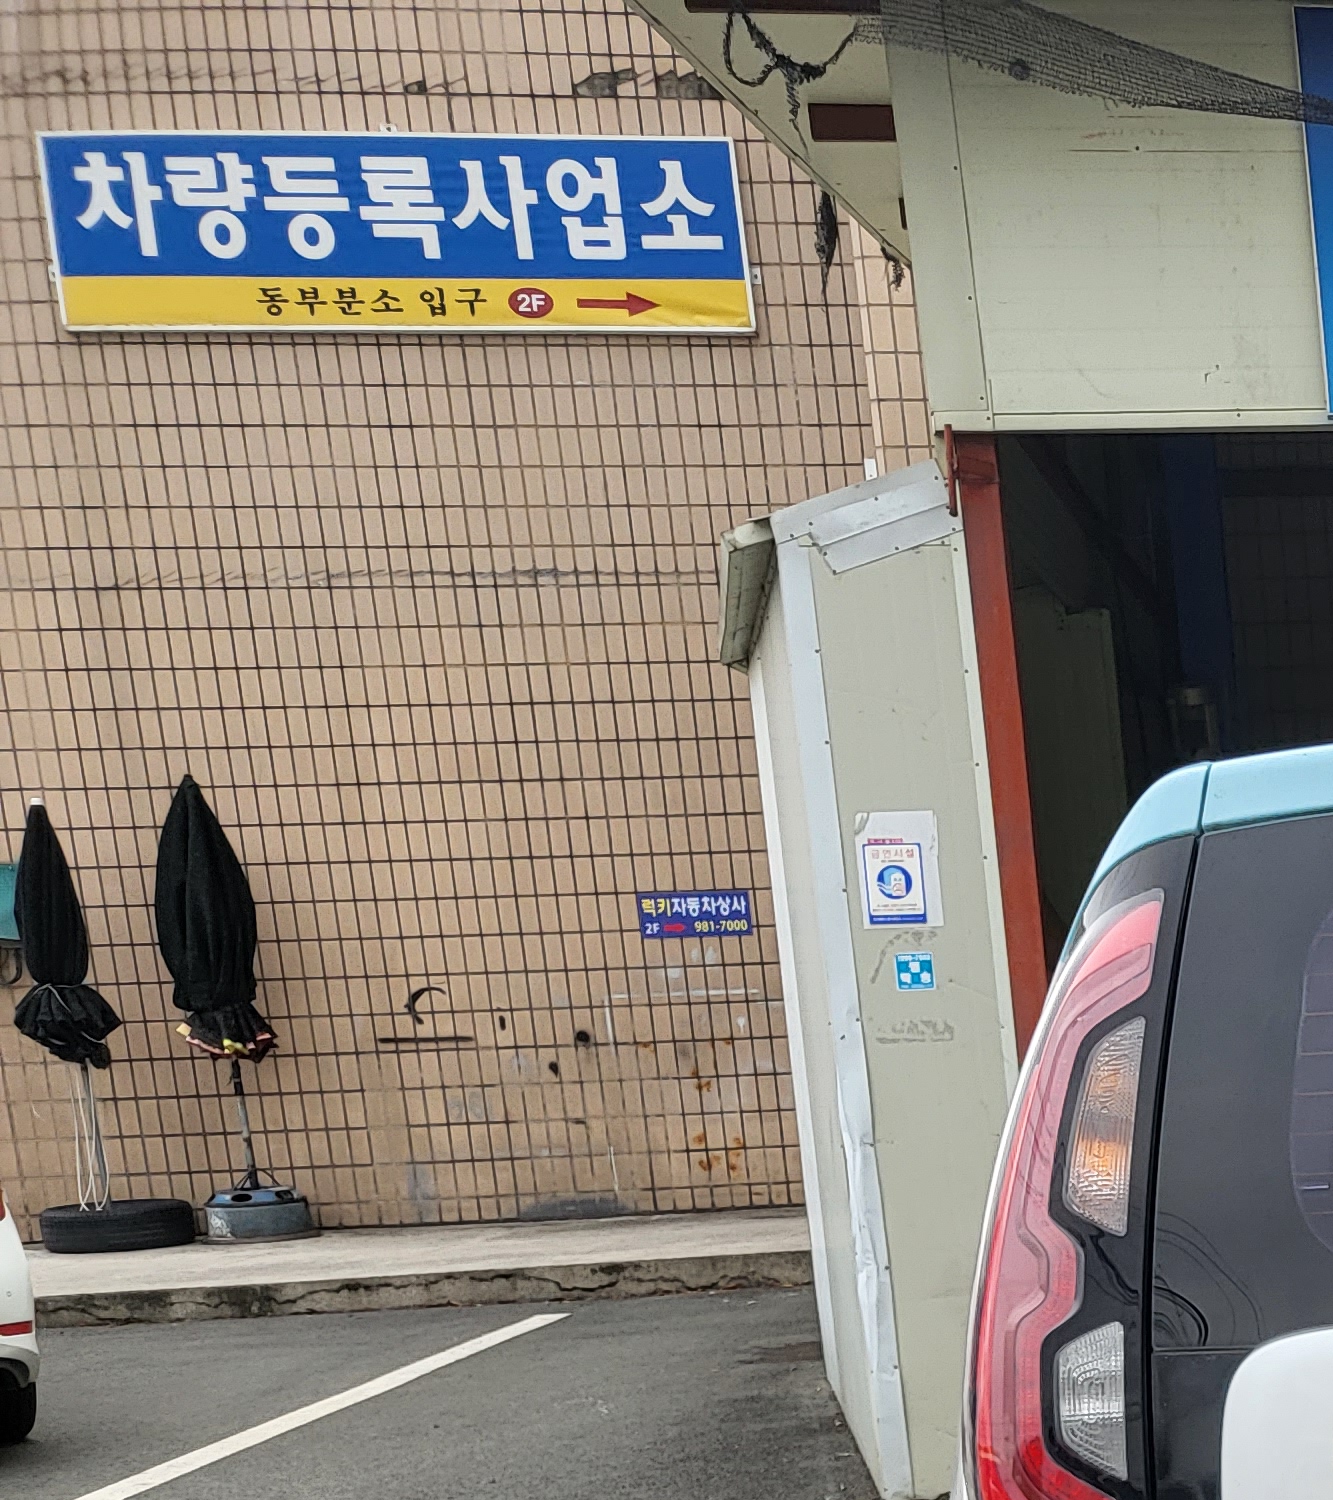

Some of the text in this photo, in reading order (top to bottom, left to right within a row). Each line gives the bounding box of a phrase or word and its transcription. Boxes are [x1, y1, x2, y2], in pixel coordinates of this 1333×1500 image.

[73, 150, 725, 262] 차량등록사업소
[257, 286, 548, 317] 동부분소 입구 2F
[644, 918, 749, 935] 2F 981-7000
